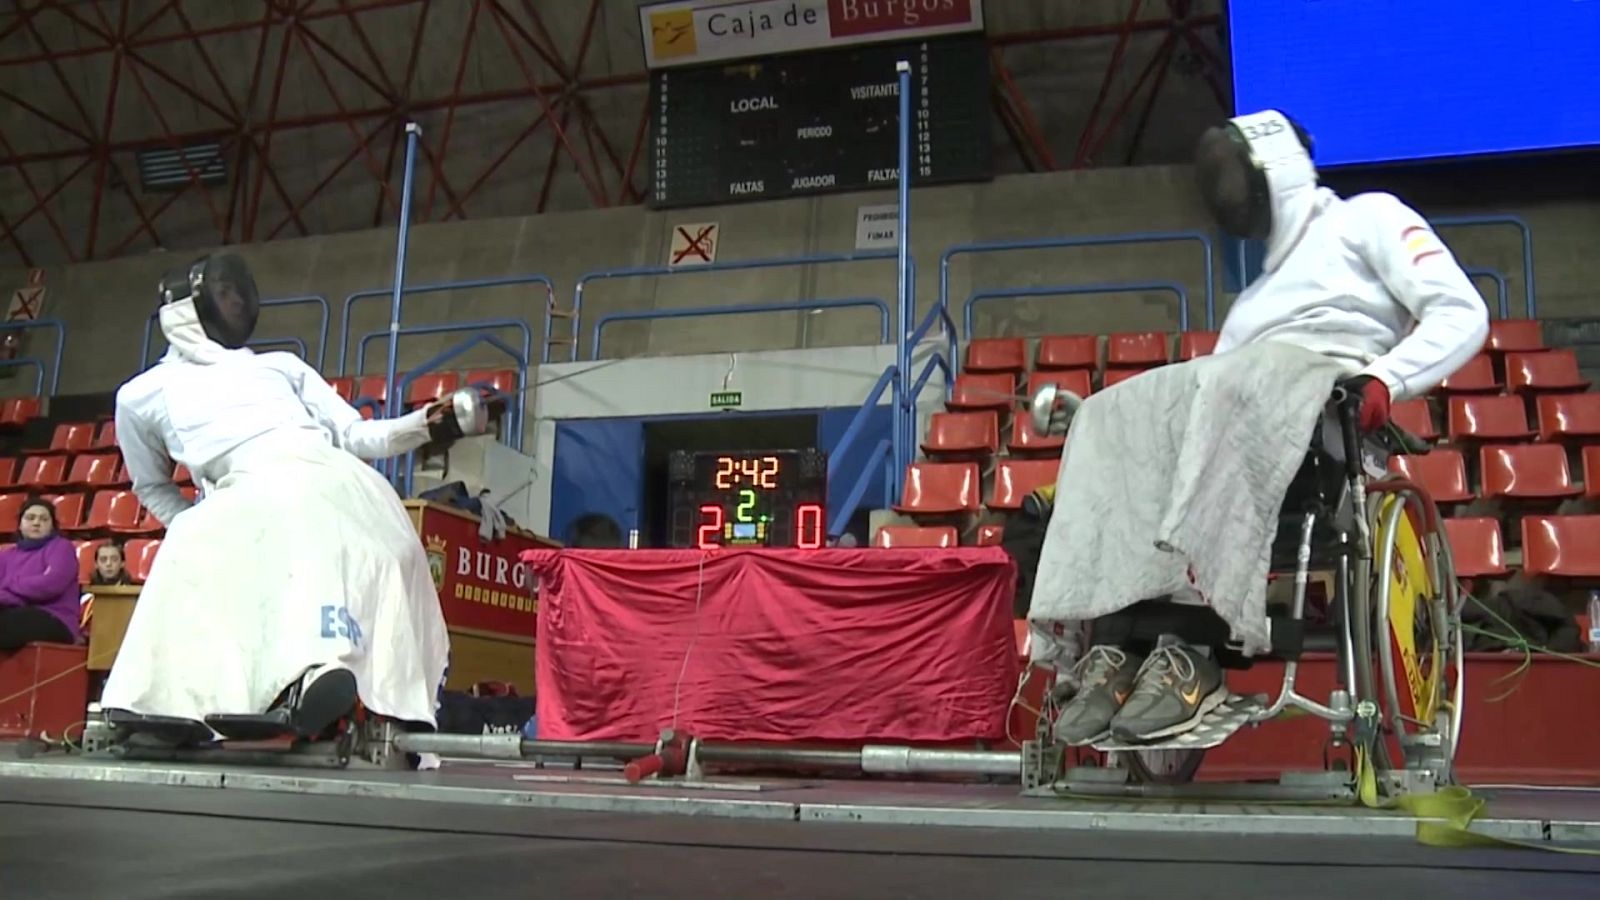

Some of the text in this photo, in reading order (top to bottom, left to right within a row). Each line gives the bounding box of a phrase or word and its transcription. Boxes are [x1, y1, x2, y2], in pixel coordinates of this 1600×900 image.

[708, 0, 954, 38] Caja de Burgos
[850, 83, 900, 99] VISITANTE
[730, 96, 778, 113] LOCAL
[917, 109, 929, 119] 10
[917, 120, 929, 130] 11
[656, 136, 668, 146] 10
[918, 131, 930, 142] 12
[656, 147, 667, 157] 11
[918, 143, 931, 153] 13
[656, 159, 667, 169] 12
[919, 154, 931, 165] 14
[655, 169, 667, 179] 13
[919, 166, 931, 177] 15
[655, 180, 667, 190] 14
[729, 180, 764, 194] FALTAS
[791, 174, 836, 190] JUGADOR
[716, 457, 778, 488] 2:42
[737, 489, 755, 521] 2
[698, 504, 821, 549] 2 0
